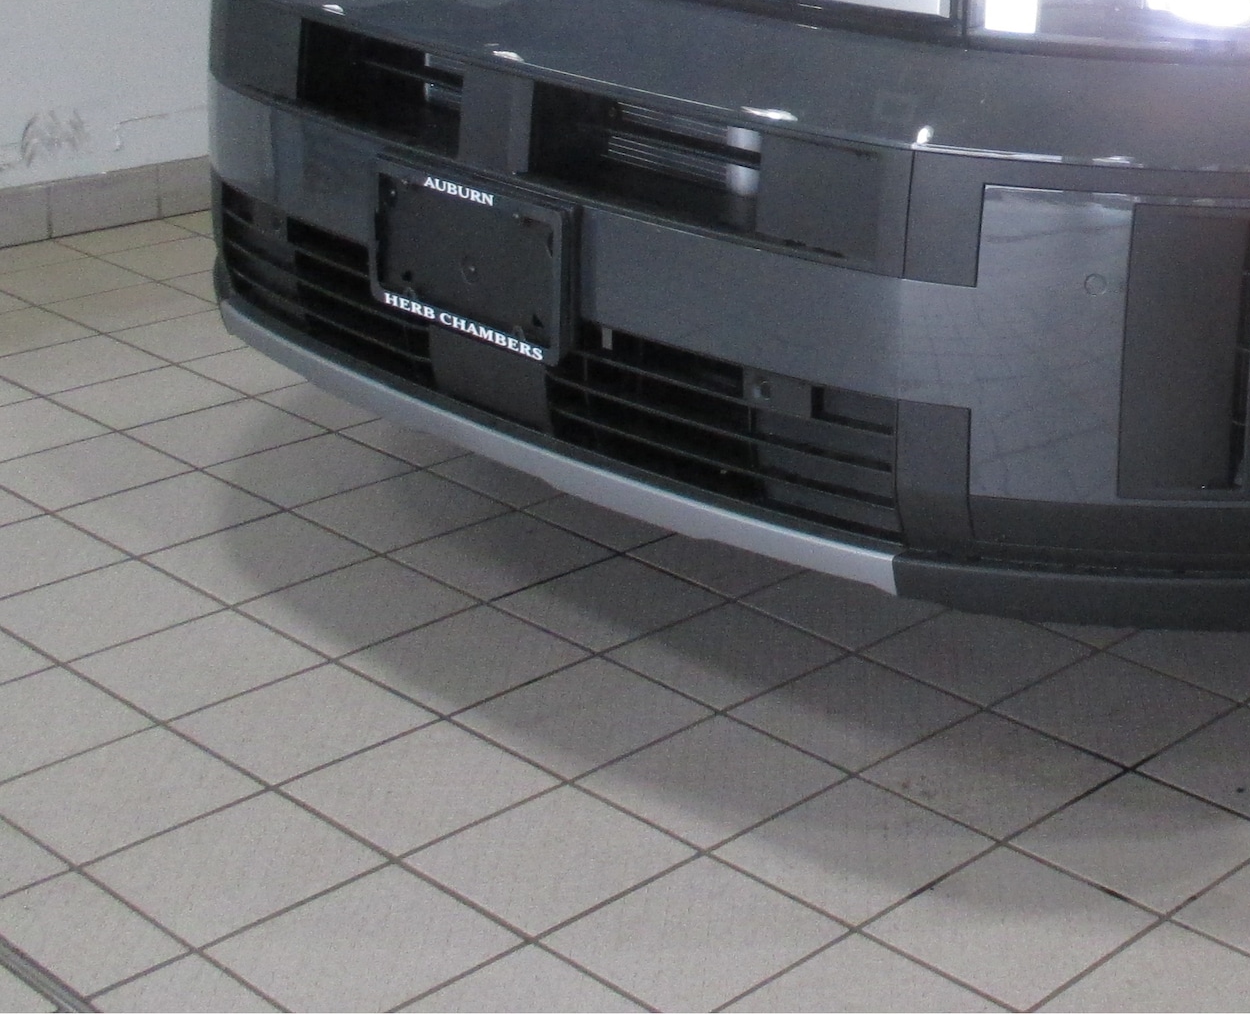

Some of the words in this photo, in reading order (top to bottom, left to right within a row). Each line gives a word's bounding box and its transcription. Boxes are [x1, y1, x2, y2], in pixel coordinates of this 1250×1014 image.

[423, 176, 494, 206] AUBURN
[384, 292, 436, 320] HERB
[439, 312, 543, 361] CHAMBERS
